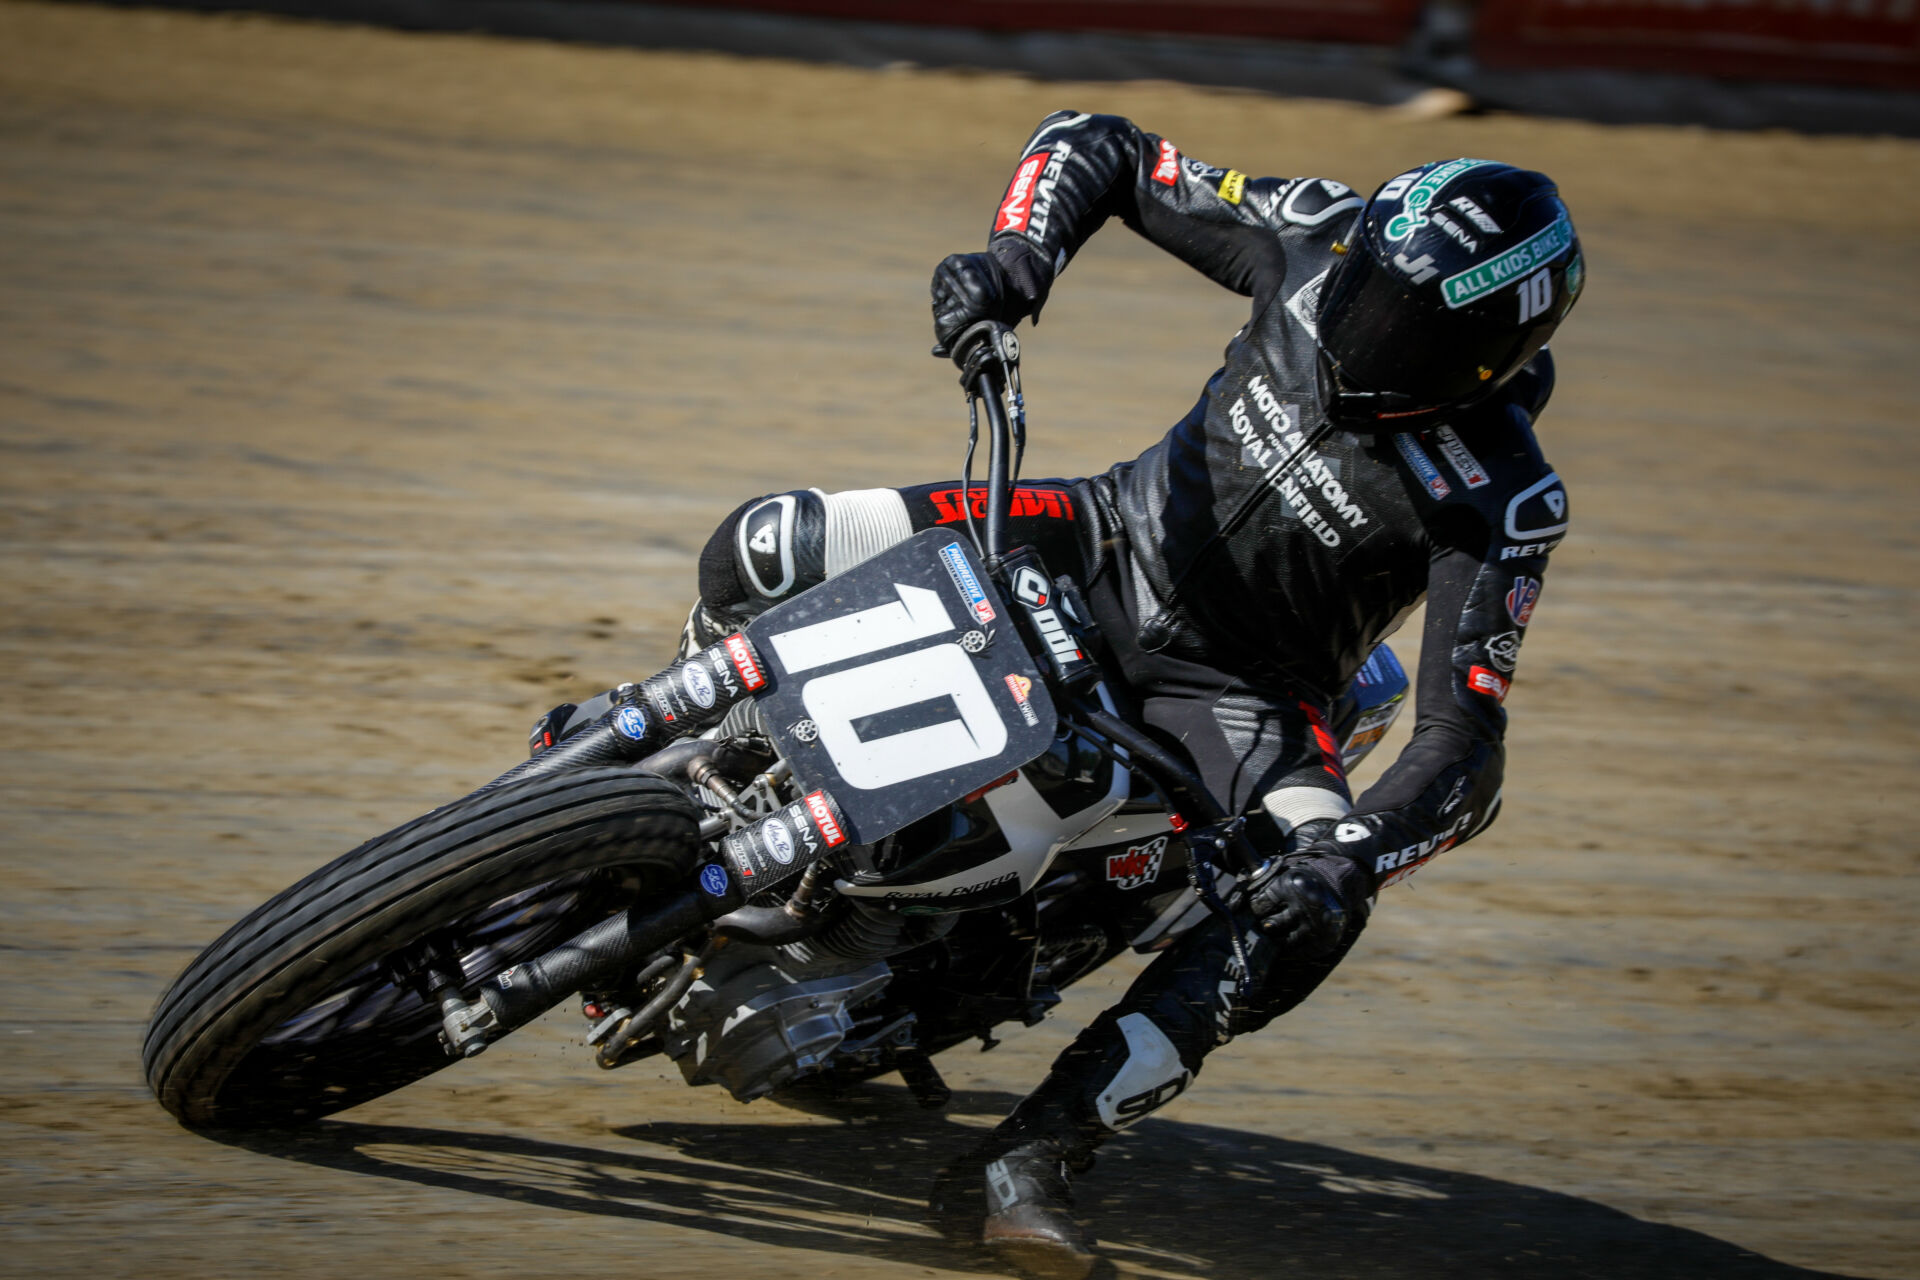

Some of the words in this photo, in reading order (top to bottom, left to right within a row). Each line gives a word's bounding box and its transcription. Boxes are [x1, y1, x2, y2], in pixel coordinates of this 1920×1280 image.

[1003, 159, 1040, 229] SENA
[1376, 171, 1424, 201] 10
[1431, 212, 1478, 254] SENA
[1454, 274, 1490, 300] ALL
[1491, 248, 1532, 282] KIDS
[1532, 231, 1561, 264] BIKE
[1515, 267, 1551, 325] 10
[1229, 398, 1274, 469] ROYAL
[1265, 461, 1341, 548] ENFIELD
[1248, 375, 1291, 434] MOTO
[1287, 431, 1368, 531] ANATOMY
[1298, 473, 1313, 490] BY
[948, 547, 984, 602] PROGRESSIVE
[709, 648, 739, 698] SENA
[727, 638, 761, 688] MOTUL
[769, 583, 1008, 790] 10
[620, 709, 642, 736] S&S
[788, 805, 817, 854] SENA
[807, 794, 841, 848] MOTUL
[704, 867, 726, 892] S&S
[950, 871, 1020, 897] ENFIELD
